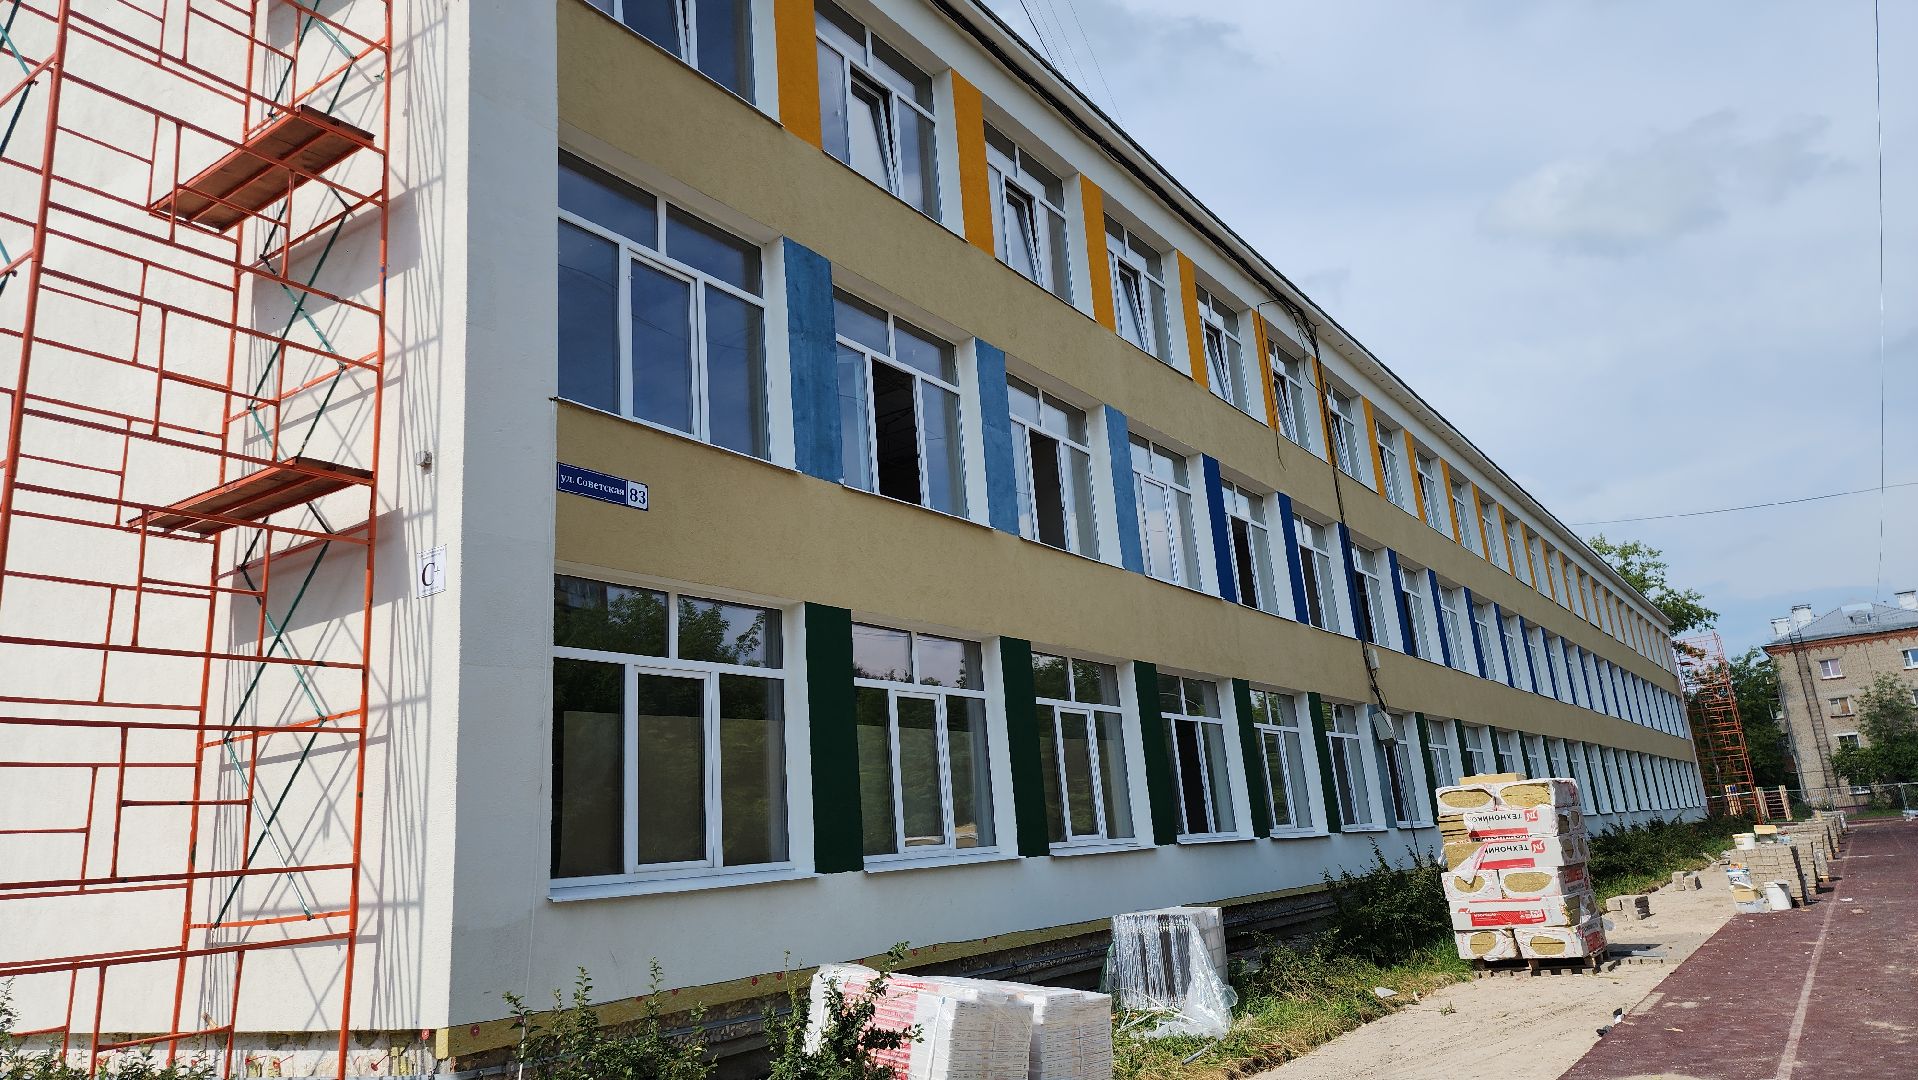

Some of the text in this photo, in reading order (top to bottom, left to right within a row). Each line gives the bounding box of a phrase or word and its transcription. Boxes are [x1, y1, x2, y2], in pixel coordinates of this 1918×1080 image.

[560, 474, 646, 505] ул. Советская 83
